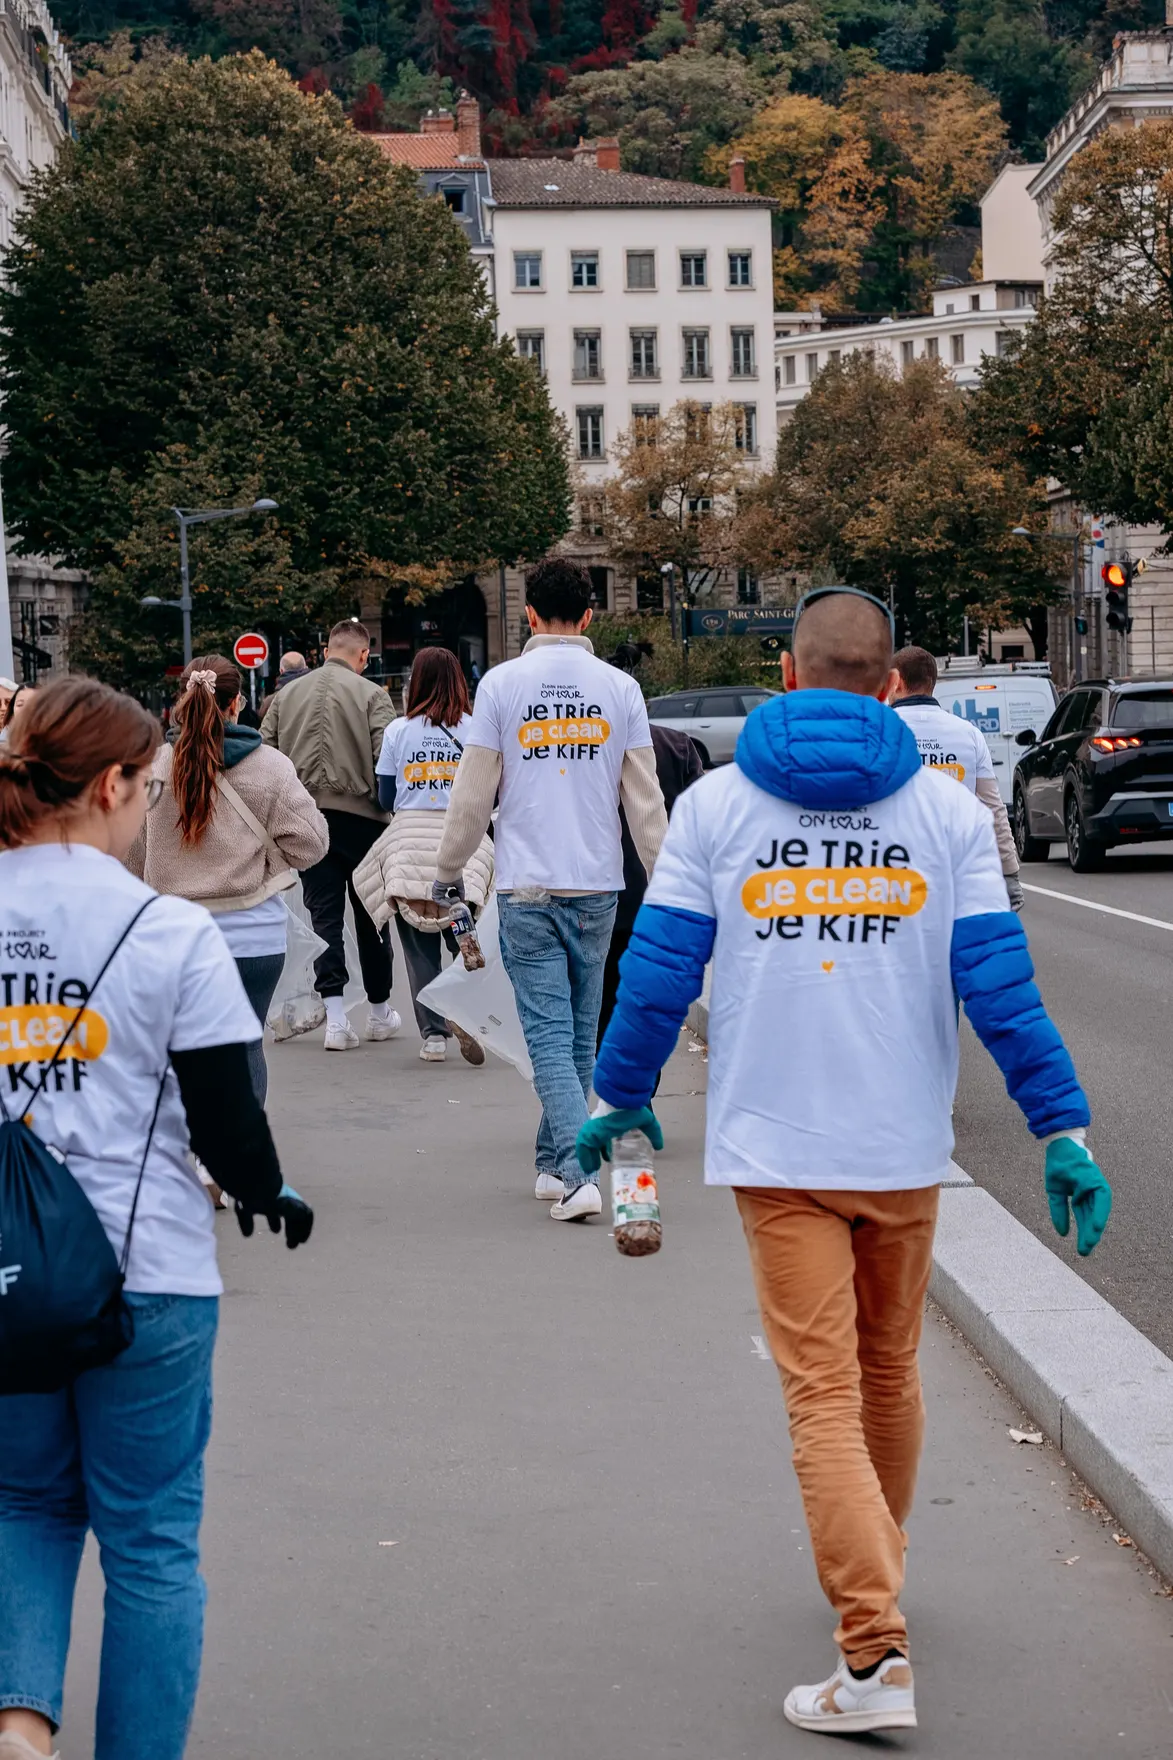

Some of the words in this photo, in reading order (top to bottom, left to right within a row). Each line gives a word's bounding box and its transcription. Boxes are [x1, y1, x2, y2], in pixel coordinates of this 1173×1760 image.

[728, 609, 751, 619] PARC
[753, 608, 805, 619] SAINT-GE
[541, 690, 554, 698] ON
[799, 813, 826, 828] ON
